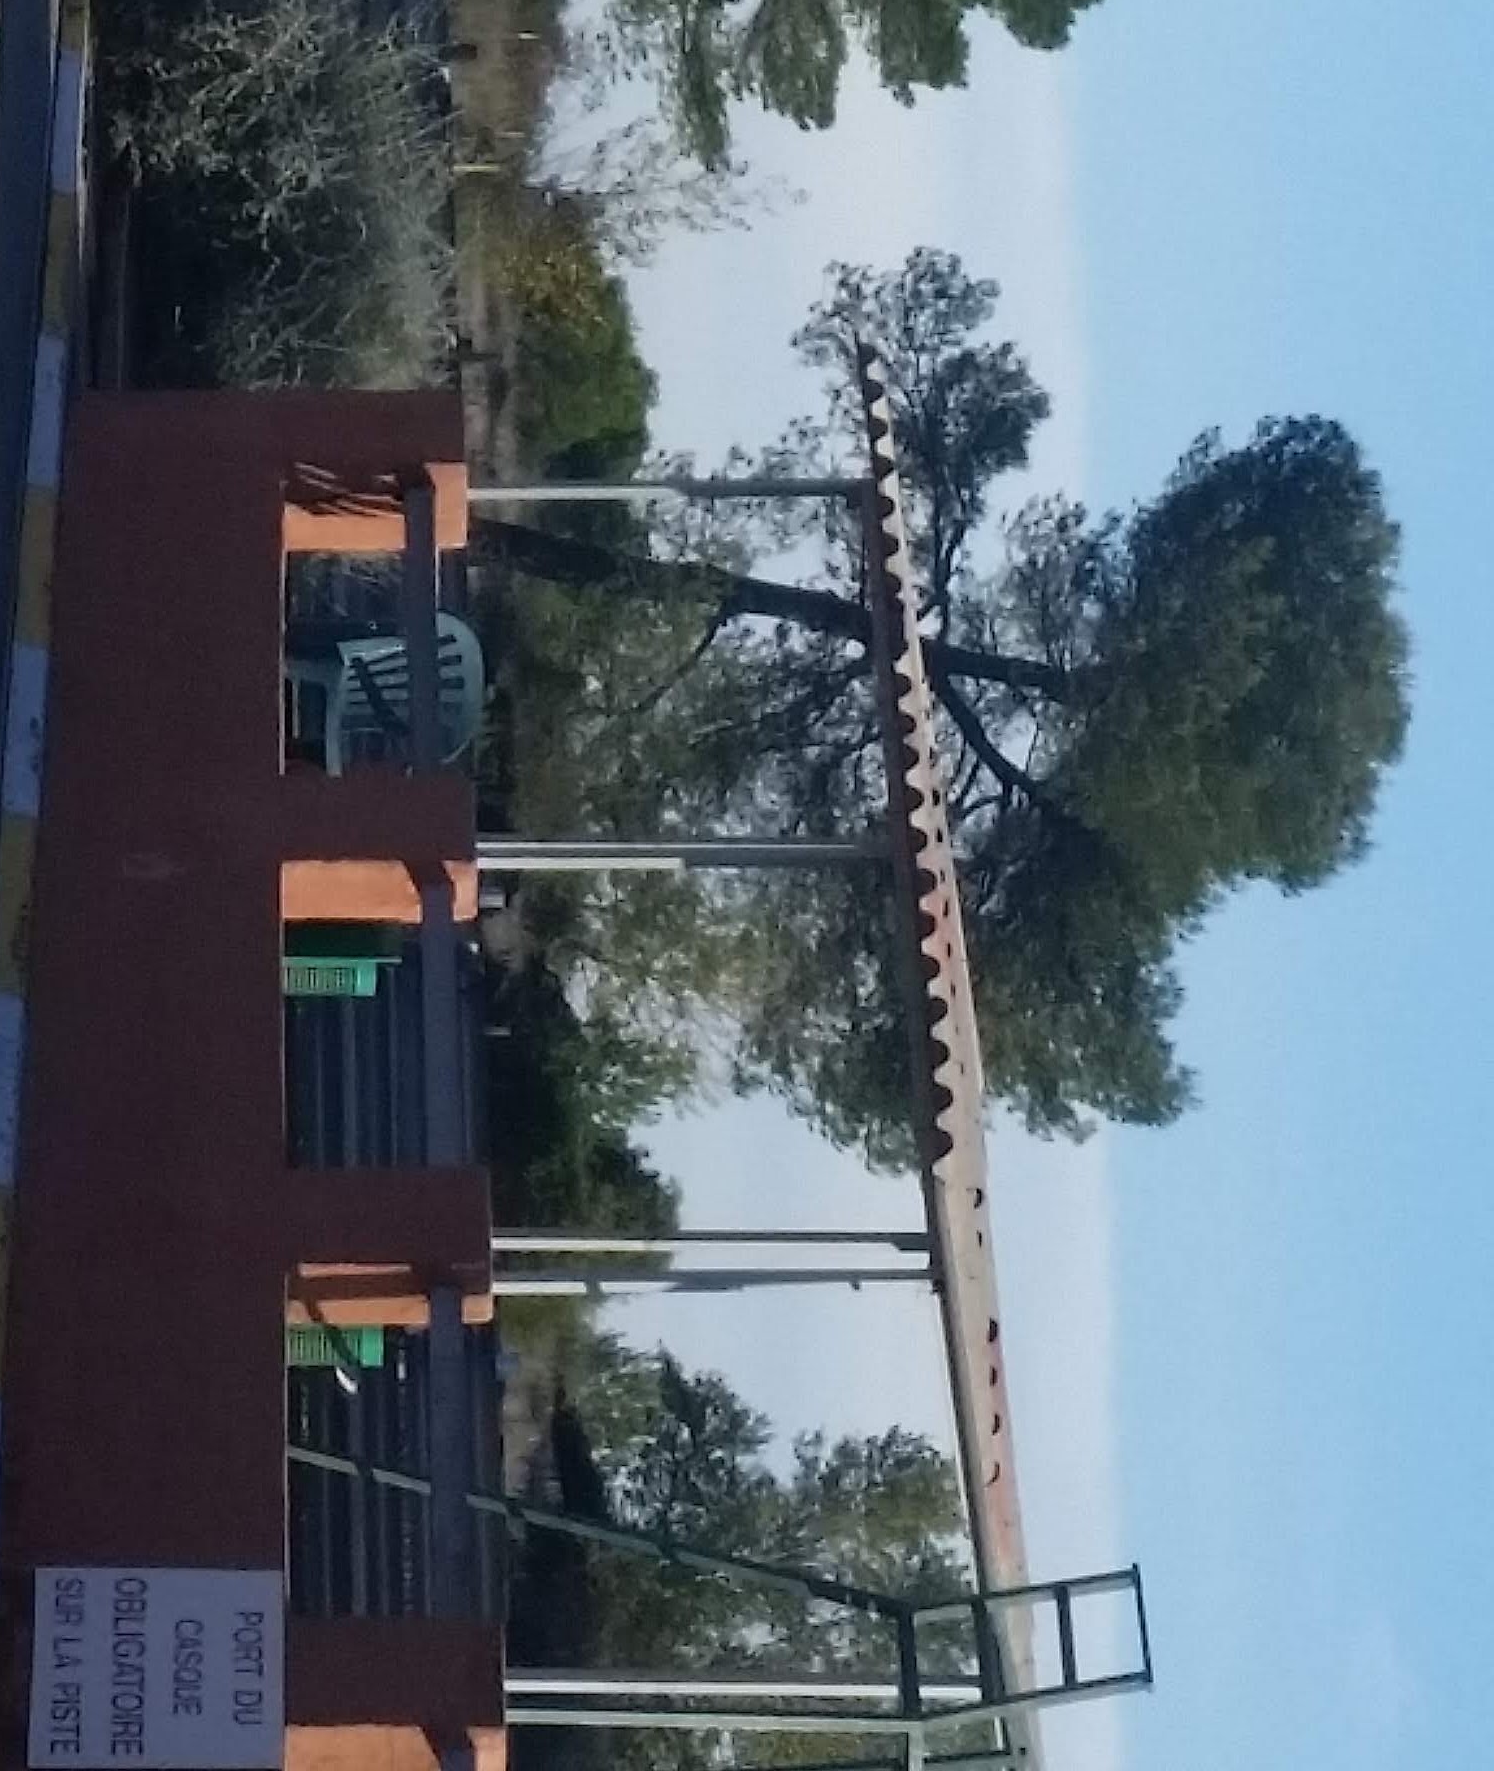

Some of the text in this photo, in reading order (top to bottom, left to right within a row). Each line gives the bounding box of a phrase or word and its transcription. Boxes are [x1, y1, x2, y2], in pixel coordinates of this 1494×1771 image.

[49, 1577, 86, 1756] SUR LA PISTE
[110, 1577, 148, 1757] OBLIGATOIRE
[172, 1619, 205, 1717] CASQUE
[232, 1611, 265, 1727] PORT DU
